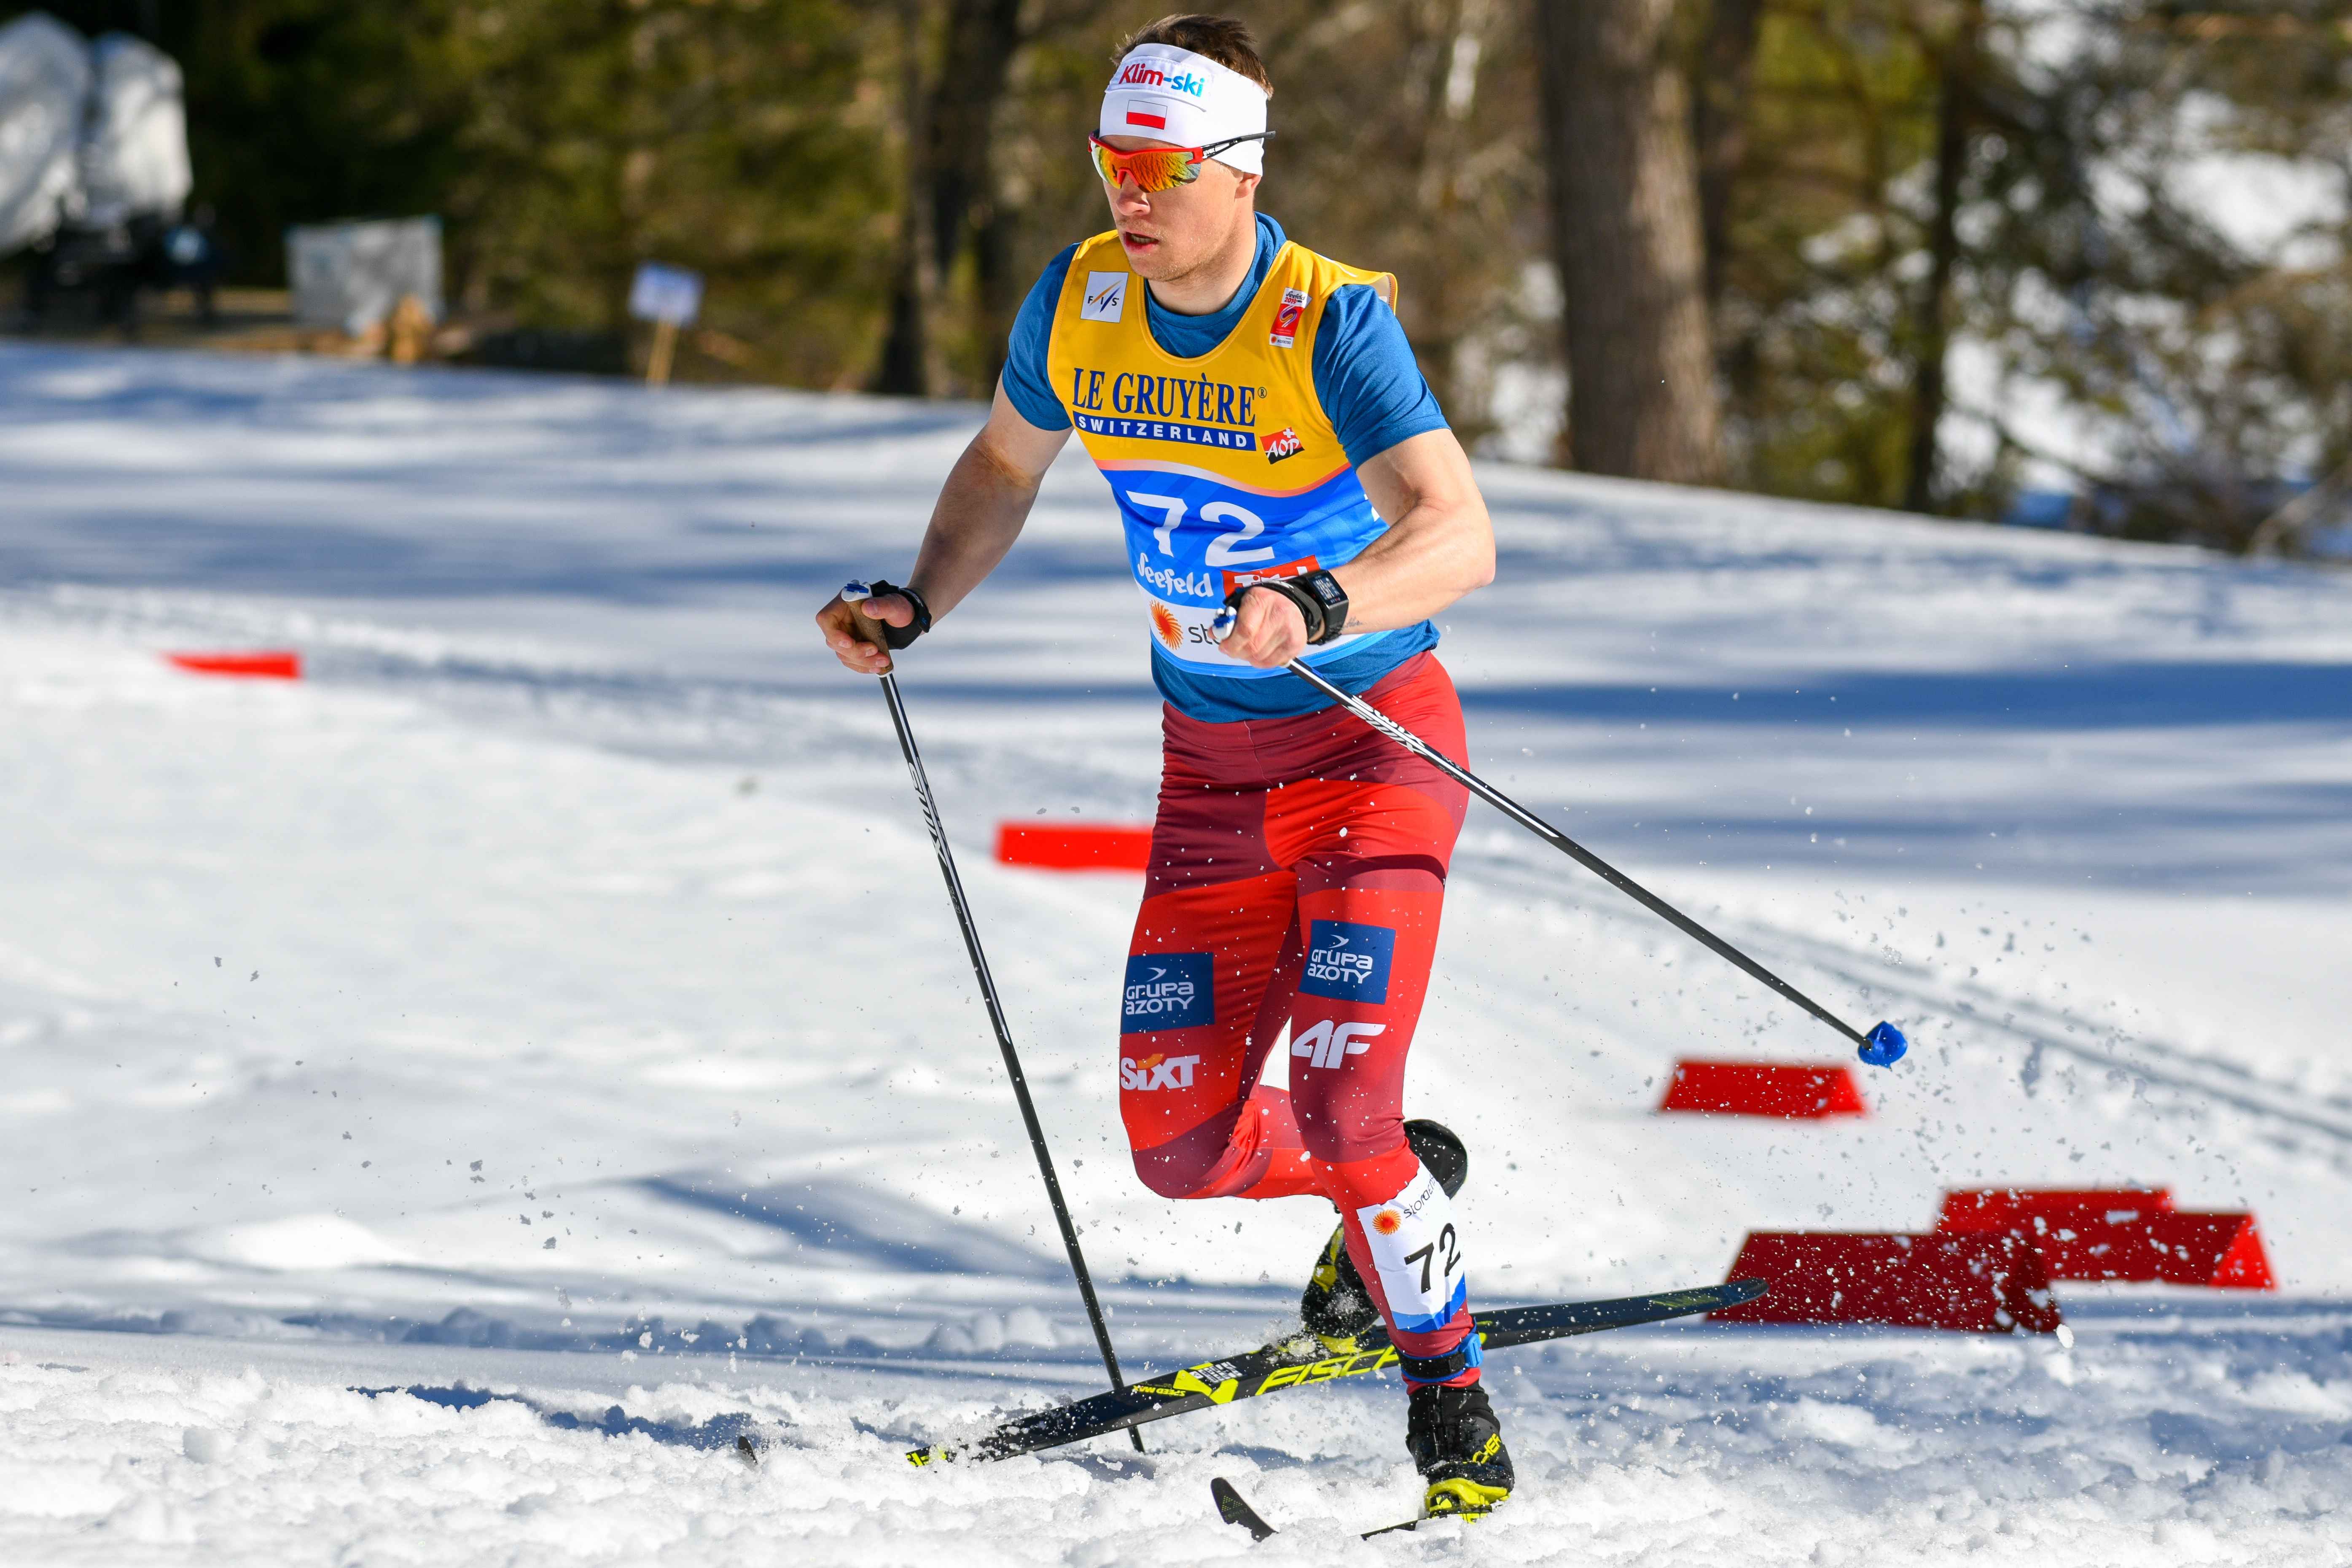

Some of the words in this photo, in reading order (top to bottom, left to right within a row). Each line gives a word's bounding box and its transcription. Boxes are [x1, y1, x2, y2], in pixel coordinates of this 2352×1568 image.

[1119, 63, 1205, 97] Klim-ski
[1088, 296, 1119, 306] FIS
[1073, 368, 1105, 410] LE
[1078, 415, 1247, 447] SWITZERLAND
[1266, 437, 1301, 463] AOP
[1126, 490, 1275, 567] 72
[1138, 552, 1214, 598] Seefeld
[1291, 1019, 1386, 1069] 4F
[1404, 1223, 1461, 1294] 72
[1156, 1388, 1186, 1397] SPEED
